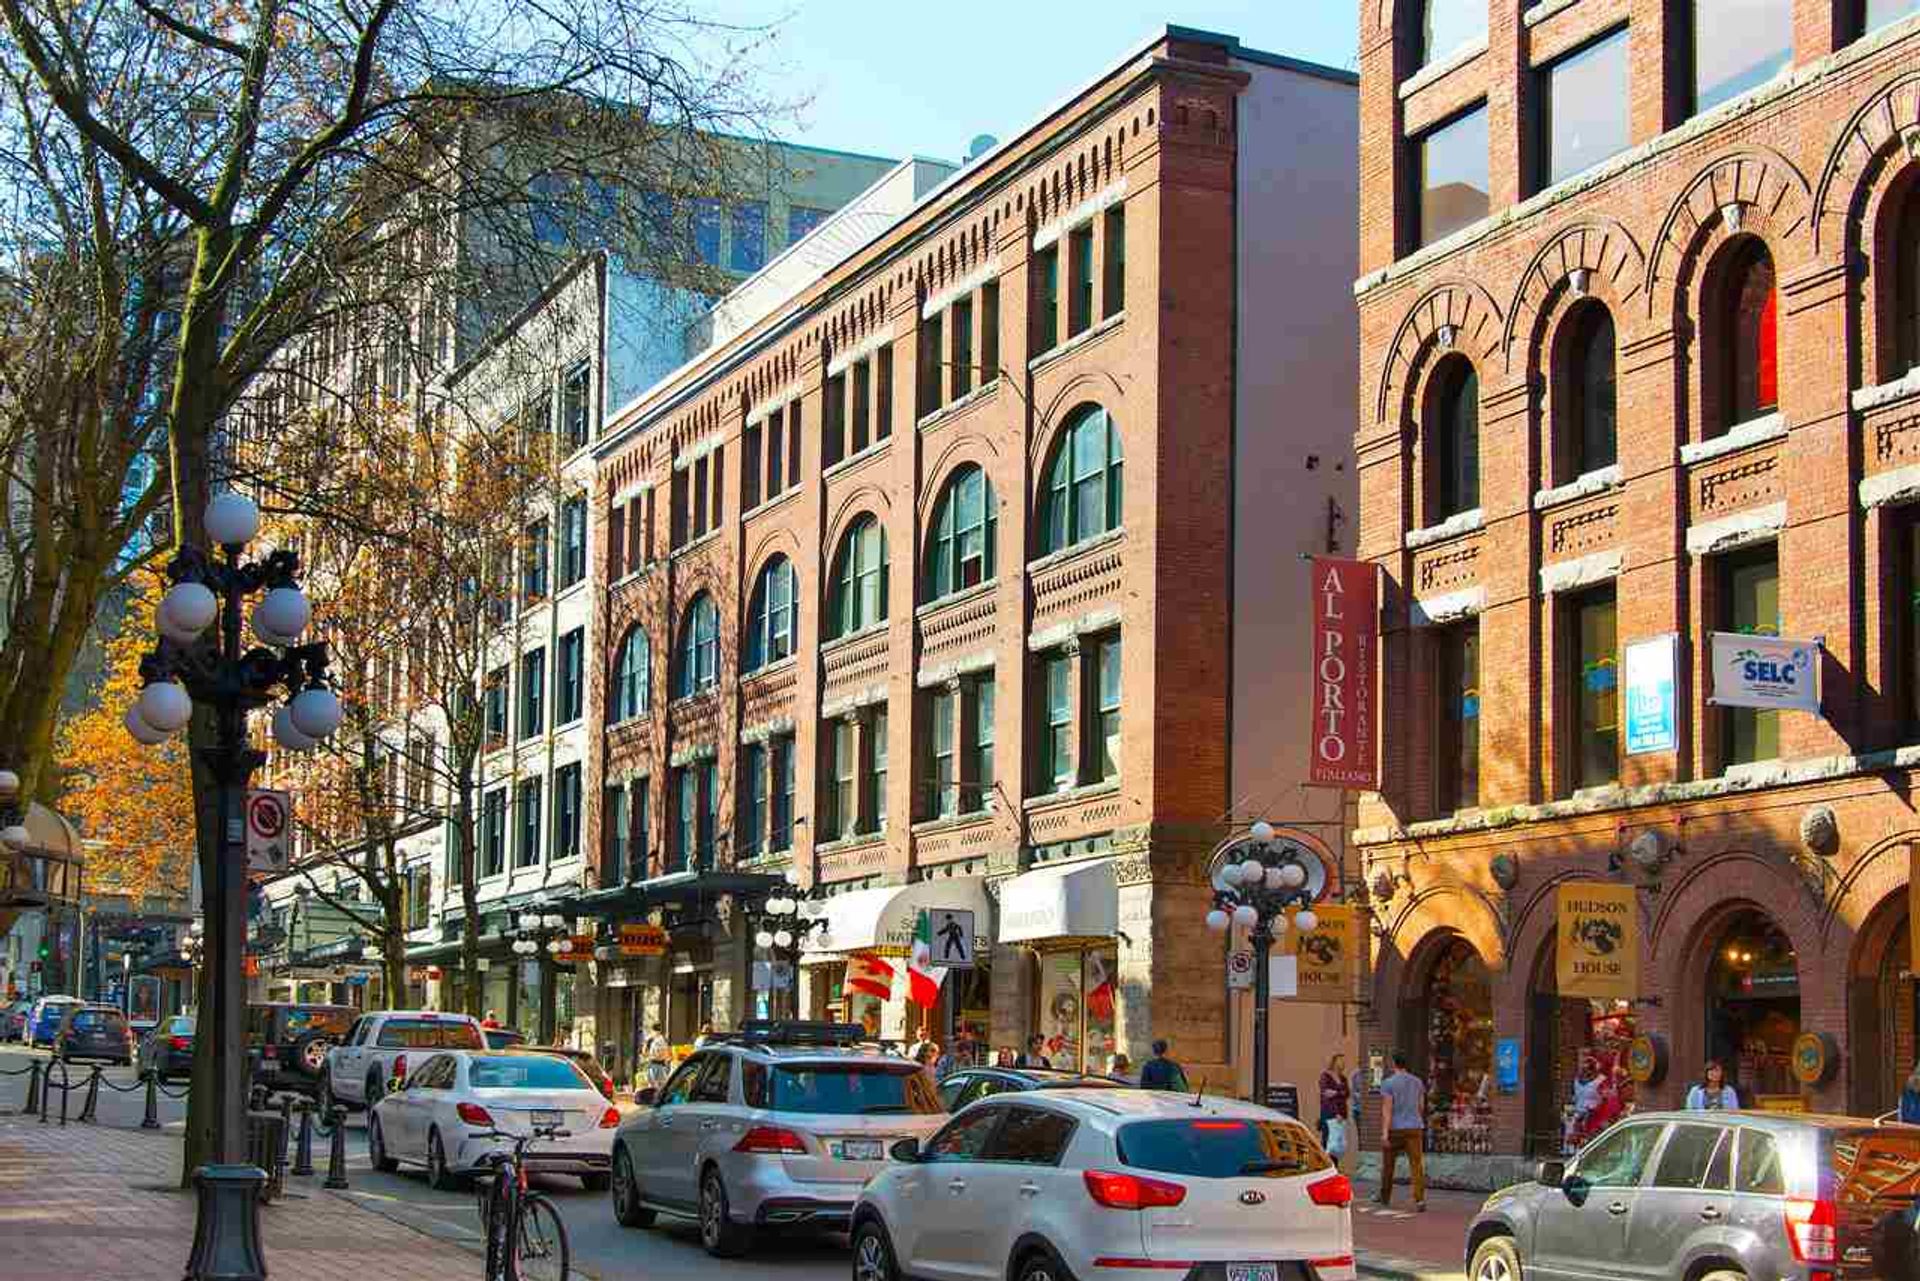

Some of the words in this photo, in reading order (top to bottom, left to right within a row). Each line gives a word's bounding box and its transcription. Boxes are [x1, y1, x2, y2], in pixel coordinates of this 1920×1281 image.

[1320, 566, 1345, 620] AL
[1743, 660, 1796, 685] SELC
[1319, 630, 1346, 761] PORTO
[1567, 900, 1629, 914] HUDSON
[1572, 961, 1622, 975] HOUSE
[1242, 1190, 1265, 1202] KIA
